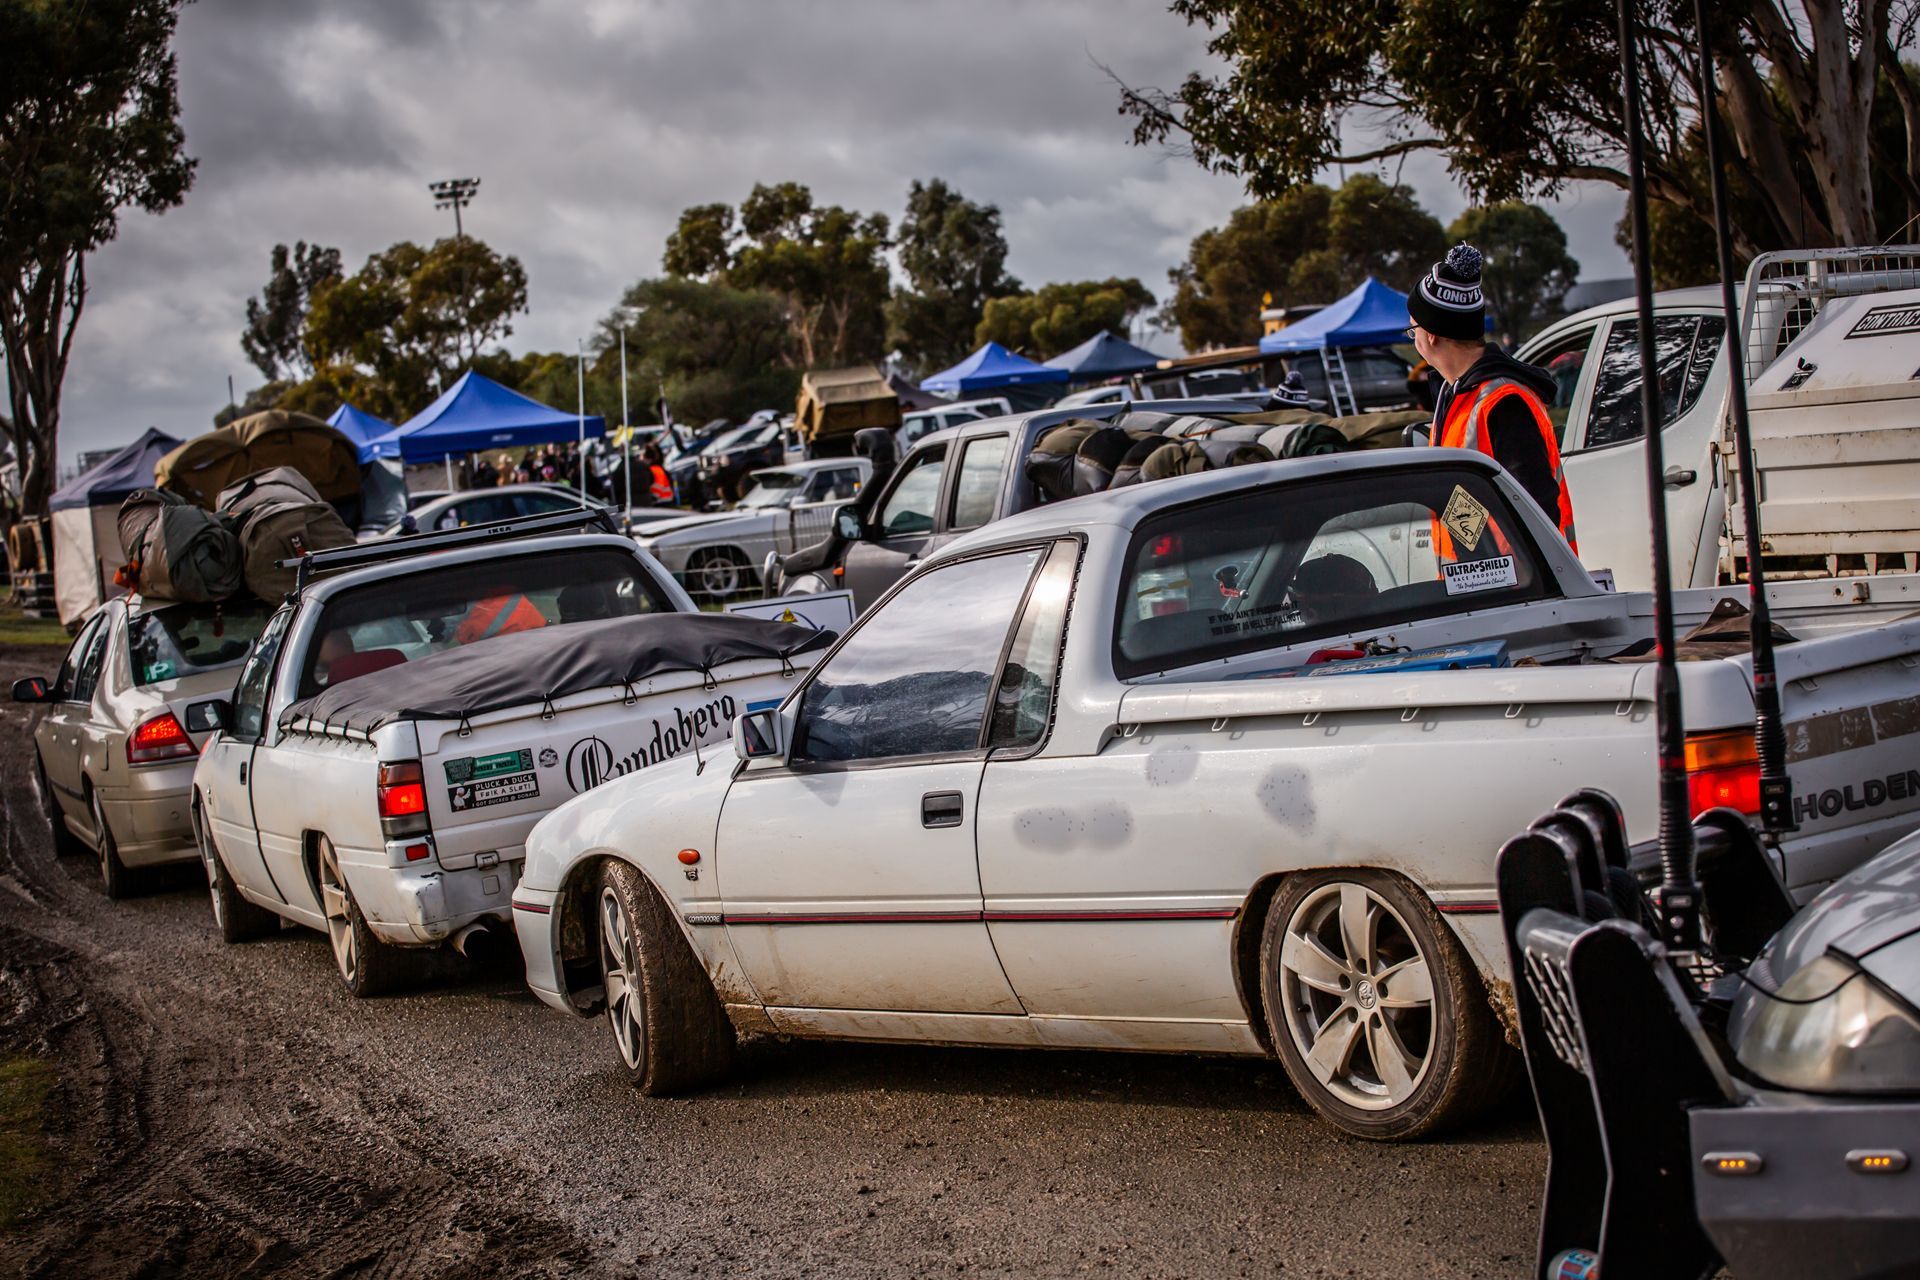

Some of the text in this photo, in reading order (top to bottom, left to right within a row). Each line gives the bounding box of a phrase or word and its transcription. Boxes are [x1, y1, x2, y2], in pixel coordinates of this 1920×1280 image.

[488, 526, 512, 535] IKEA
[1472, 570, 1506, 579] PRODUCTS
[1217, 611, 1234, 622] YOU
[149, 661, 169, 680] P
[475, 780, 501, 791] PLUCK
[511, 774, 534, 784] DUCK
[501, 787, 507, 795] A
[517, 791, 540, 800] DONALD
[688, 915, 721, 923] COMMODORE
